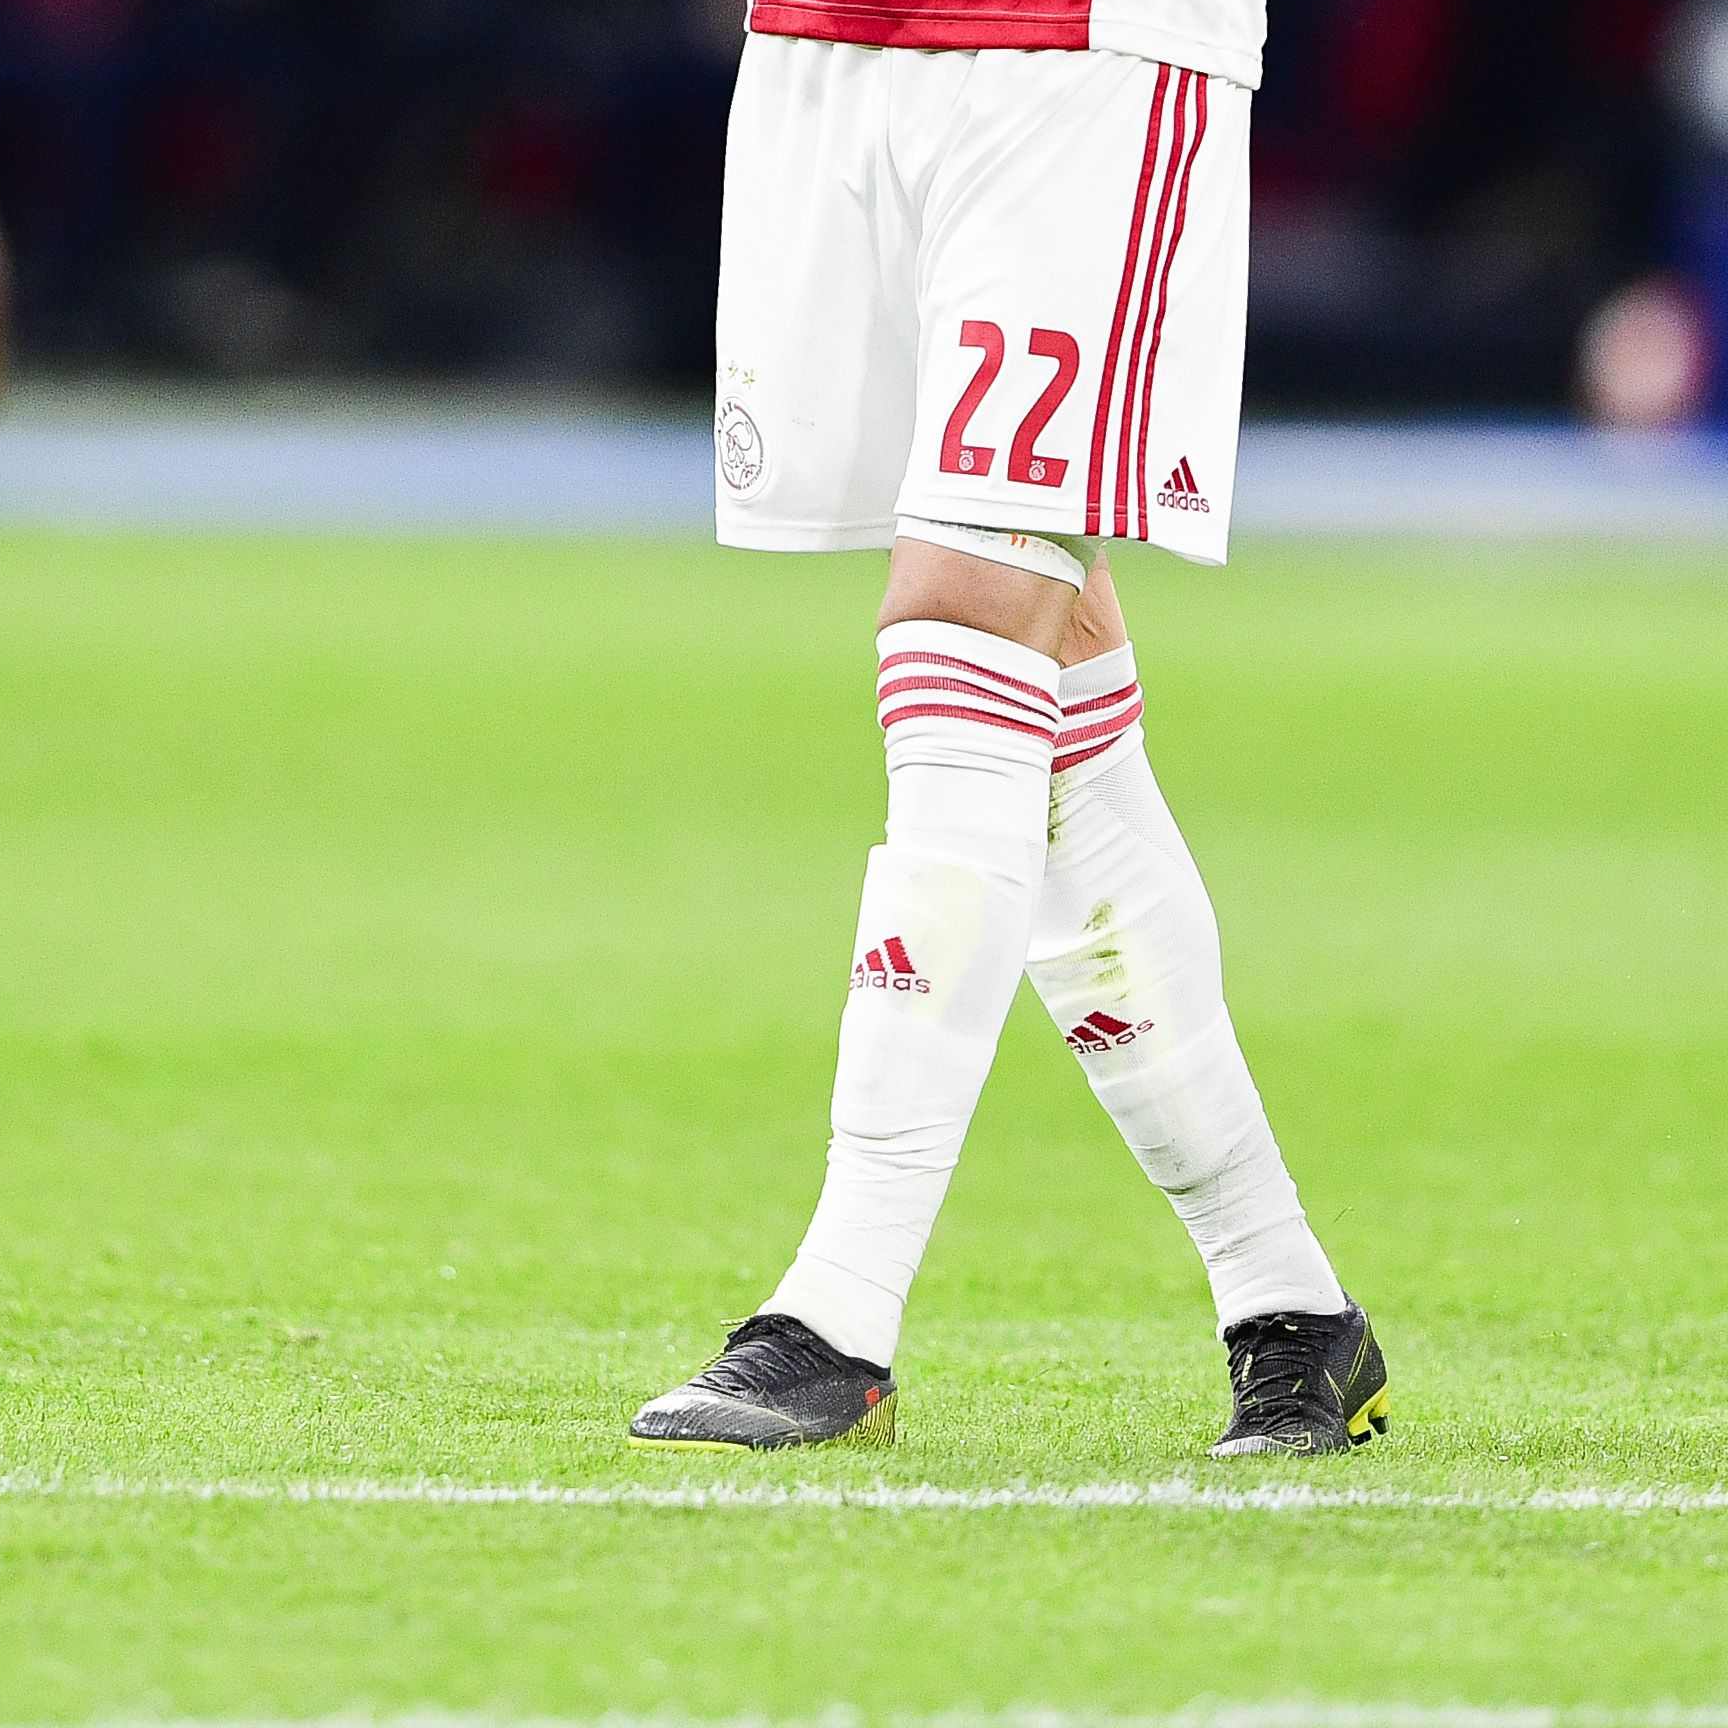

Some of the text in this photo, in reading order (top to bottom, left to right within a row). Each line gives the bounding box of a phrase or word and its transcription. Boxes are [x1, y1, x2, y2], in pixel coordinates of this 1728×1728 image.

[939, 320, 1080, 488] 22
[1157, 490, 1210, 513] adidas
[1071, 1019, 1155, 1054] didas
